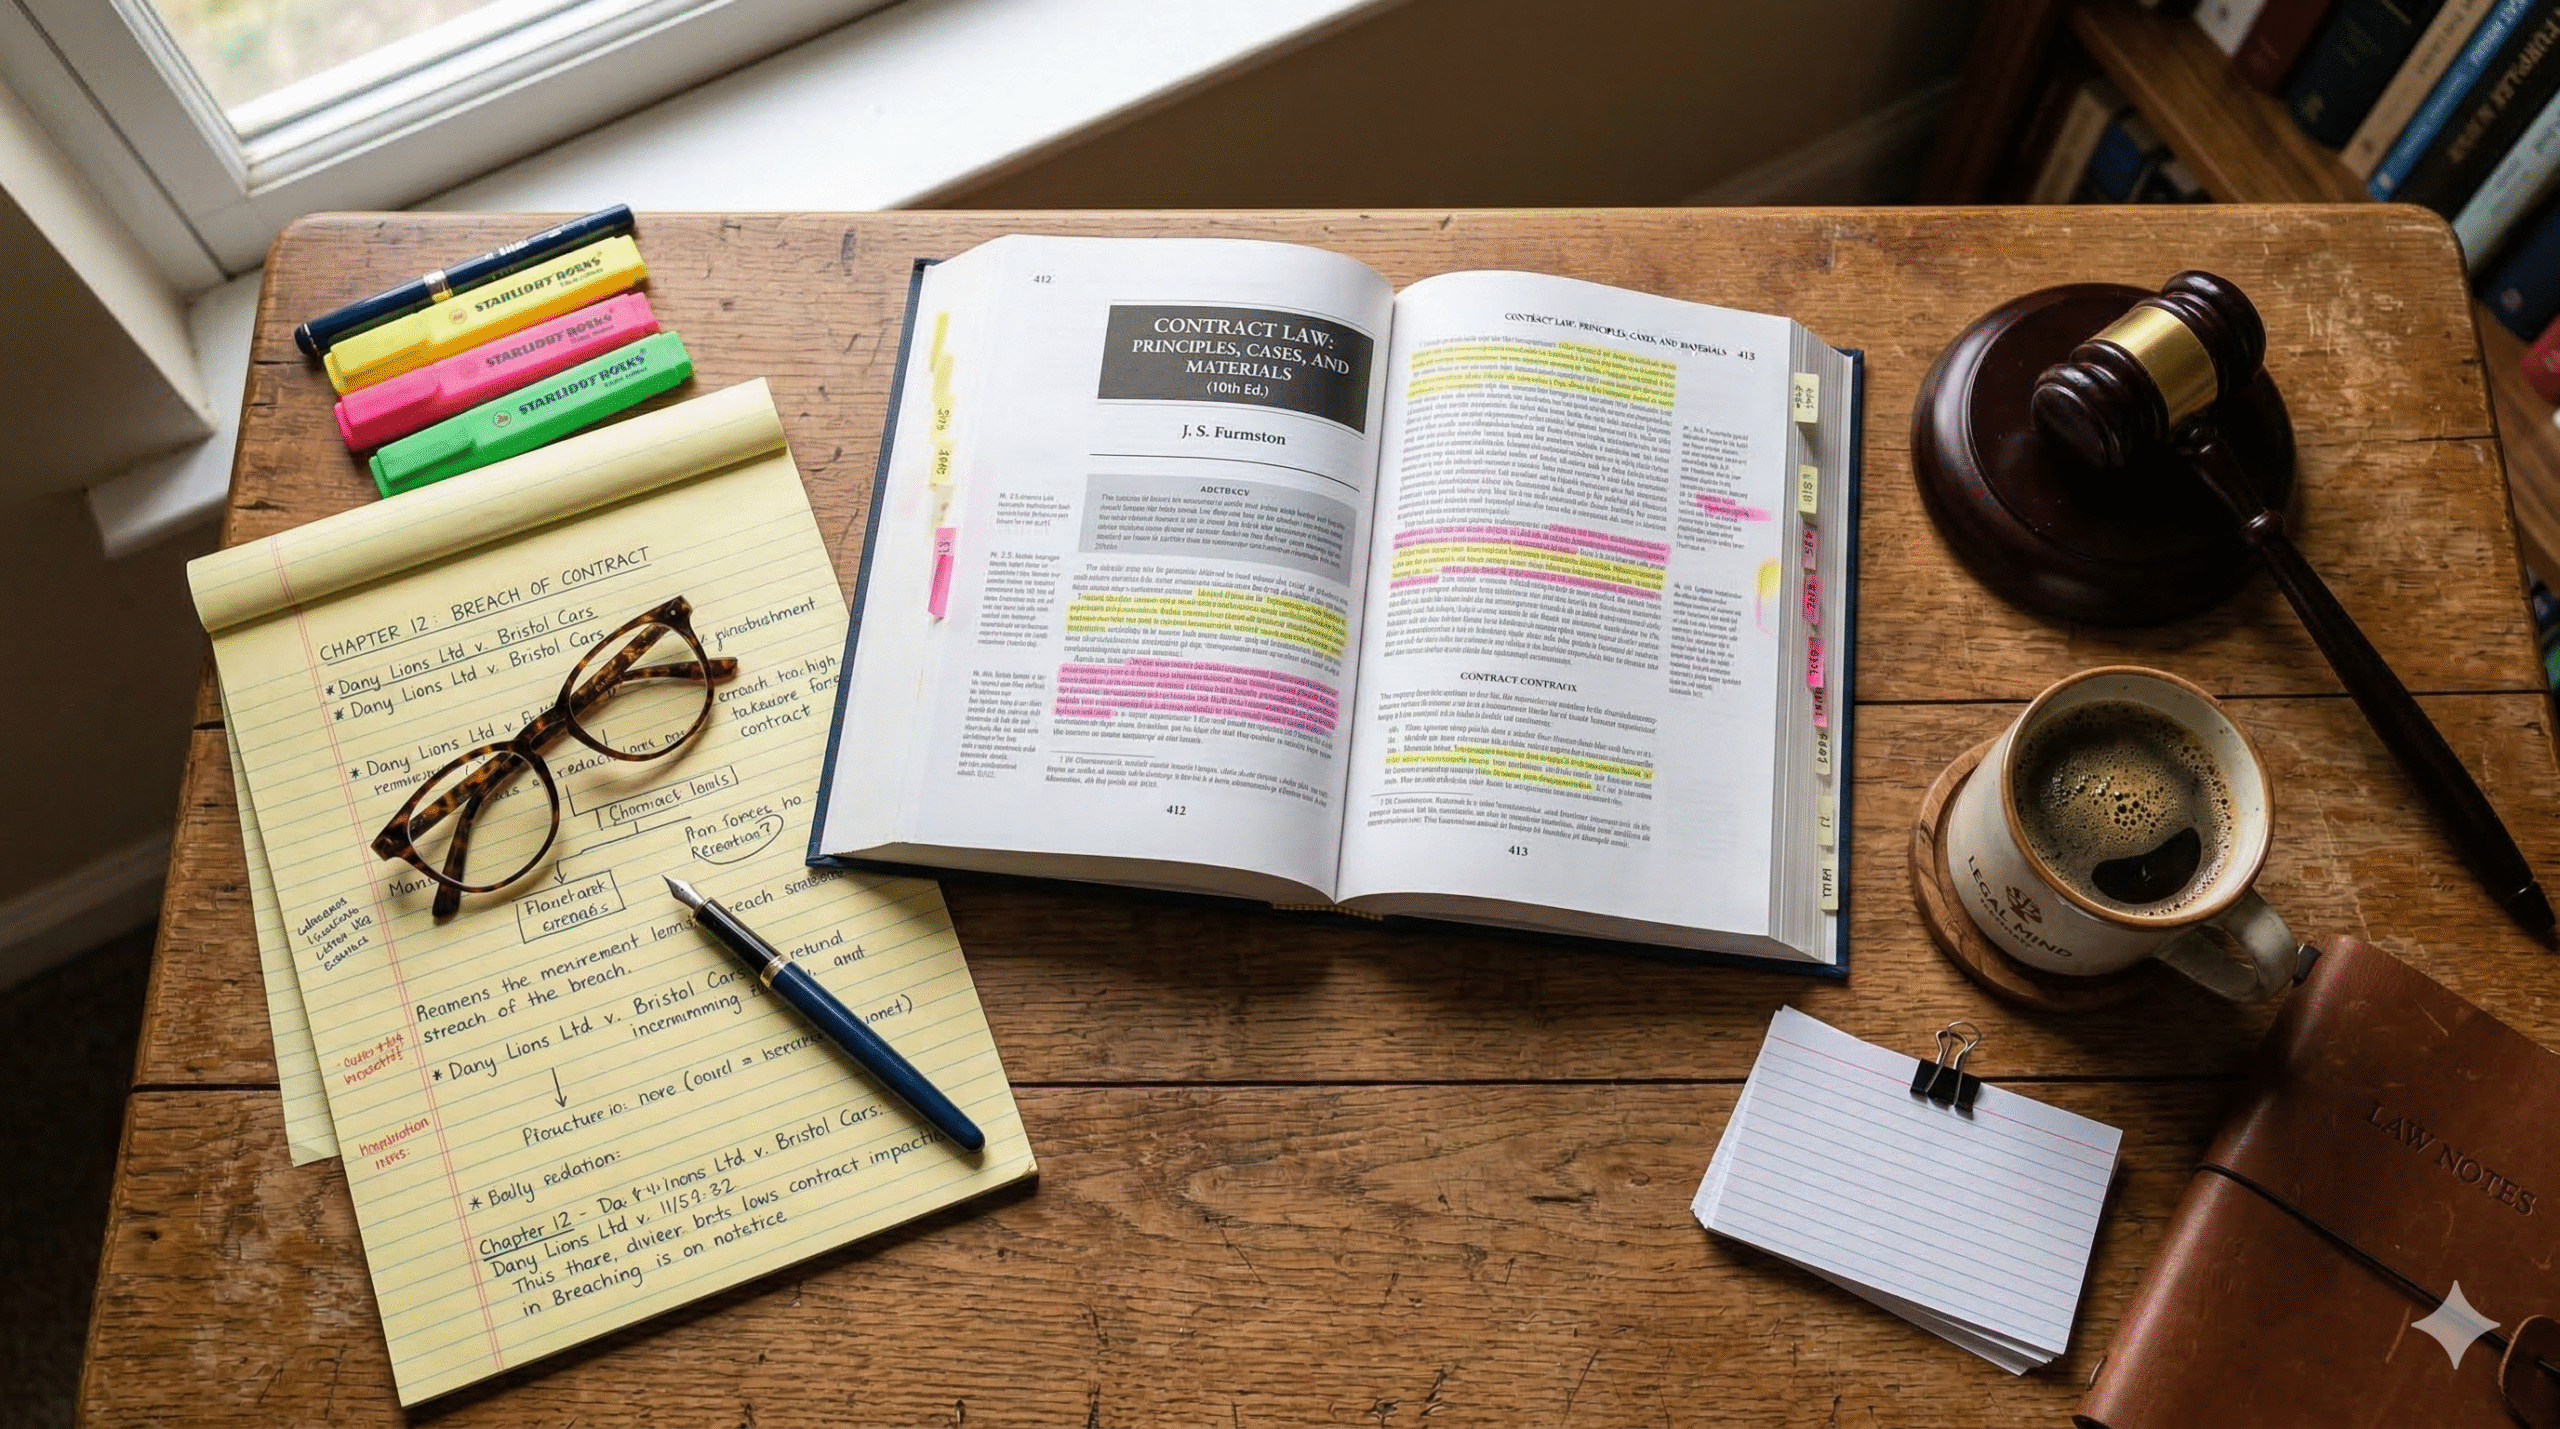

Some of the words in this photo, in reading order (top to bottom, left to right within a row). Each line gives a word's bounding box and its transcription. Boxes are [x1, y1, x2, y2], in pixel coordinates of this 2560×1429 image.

[1033, 274, 1053, 284] 412
[1132, 339, 1242, 358] PRINCIPLES,
[1246, 343, 1307, 366] CASES,
[1311, 353, 1350, 375] AND
[1154, 317, 1277, 338] CONTRACT
[1282, 324, 1334, 350] LAW:
[1186, 359, 1292, 381] MATERIALS
[1206, 381, 1241, 396] (10th
[1244, 383, 1269, 399] Ed.)
[1181, 424, 1192, 439] J.
[1196, 425, 1210, 438] S.
[1214, 425, 1286, 446] Furmston
[320, 624, 400, 662] CHAPTER
[410, 616, 439, 634] 12:
[450, 587, 521, 622] BREACH
[530, 577, 551, 596] OF
[561, 546, 650, 586] CONTRACT
[339, 676, 381, 696] Dany
[389, 658, 430, 680] Lions
[438, 643, 465, 665] Ltd
[497, 616, 550, 645] Bristol
[558, 605, 595, 626] Cars
[351, 698, 394, 719] Dany
[402, 681, 443, 703] Lions
[450, 665, 477, 686] Ltd
[509, 639, 560, 667] Bristol
[569, 628, 605, 648] Cars
[804, 655, 836, 675] high
[740, 703, 811, 738] contract
[366, 757, 411, 778] Dany
[418, 738, 459, 760] Lions
[468, 723, 495, 743] Ltd
[1166, 805, 1187, 817] 412
[1508, 845, 1529, 858] 413
[1968, 855, 2008, 922] LEGAL
[2013, 922, 2073, 958] MIND
[416, 988, 491, 1023] Reamens
[501, 976, 531, 994] the
[423, 1012, 486, 1044] streach
[498, 998, 517, 1018] of
[527, 987, 558, 1007] the
[568, 962, 632, 993] breach.
[448, 1057, 497, 1080] Dany
[506, 1034, 550, 1060] Lions
[559, 1015, 594, 1040] Ltd
[604, 1012, 621, 1025] v.
[633, 981, 695, 1016] Bristol
[707, 966, 746, 990] Cars
[479, 1223, 545, 1256] Chapter
[552, 1210, 573, 1231] 12
[714, 1147, 746, 1173] Ltd
[754, 1146, 769, 1158] v.
[775, 1116, 830, 1150] Bristol
[840, 1103, 884, 1127] Cars:
[2367, 1100, 2437, 1154] LAW
[2434, 1142, 2537, 1217] NOTES
[488, 1181, 535, 1207] Bally
[491, 1254, 538, 1278] Dany
[545, 1233, 589, 1259] Lions
[598, 1216, 629, 1240] Ltd
[512, 1270, 555, 1296] Thus
[741, 1191, 779, 1212] lows
[789, 1157, 860, 1193] contract
[522, 1302, 541, 1317] in
[552, 1266, 643, 1307] Breaching
[656, 1251, 671, 1268] is
[683, 1242, 705, 1258] on
